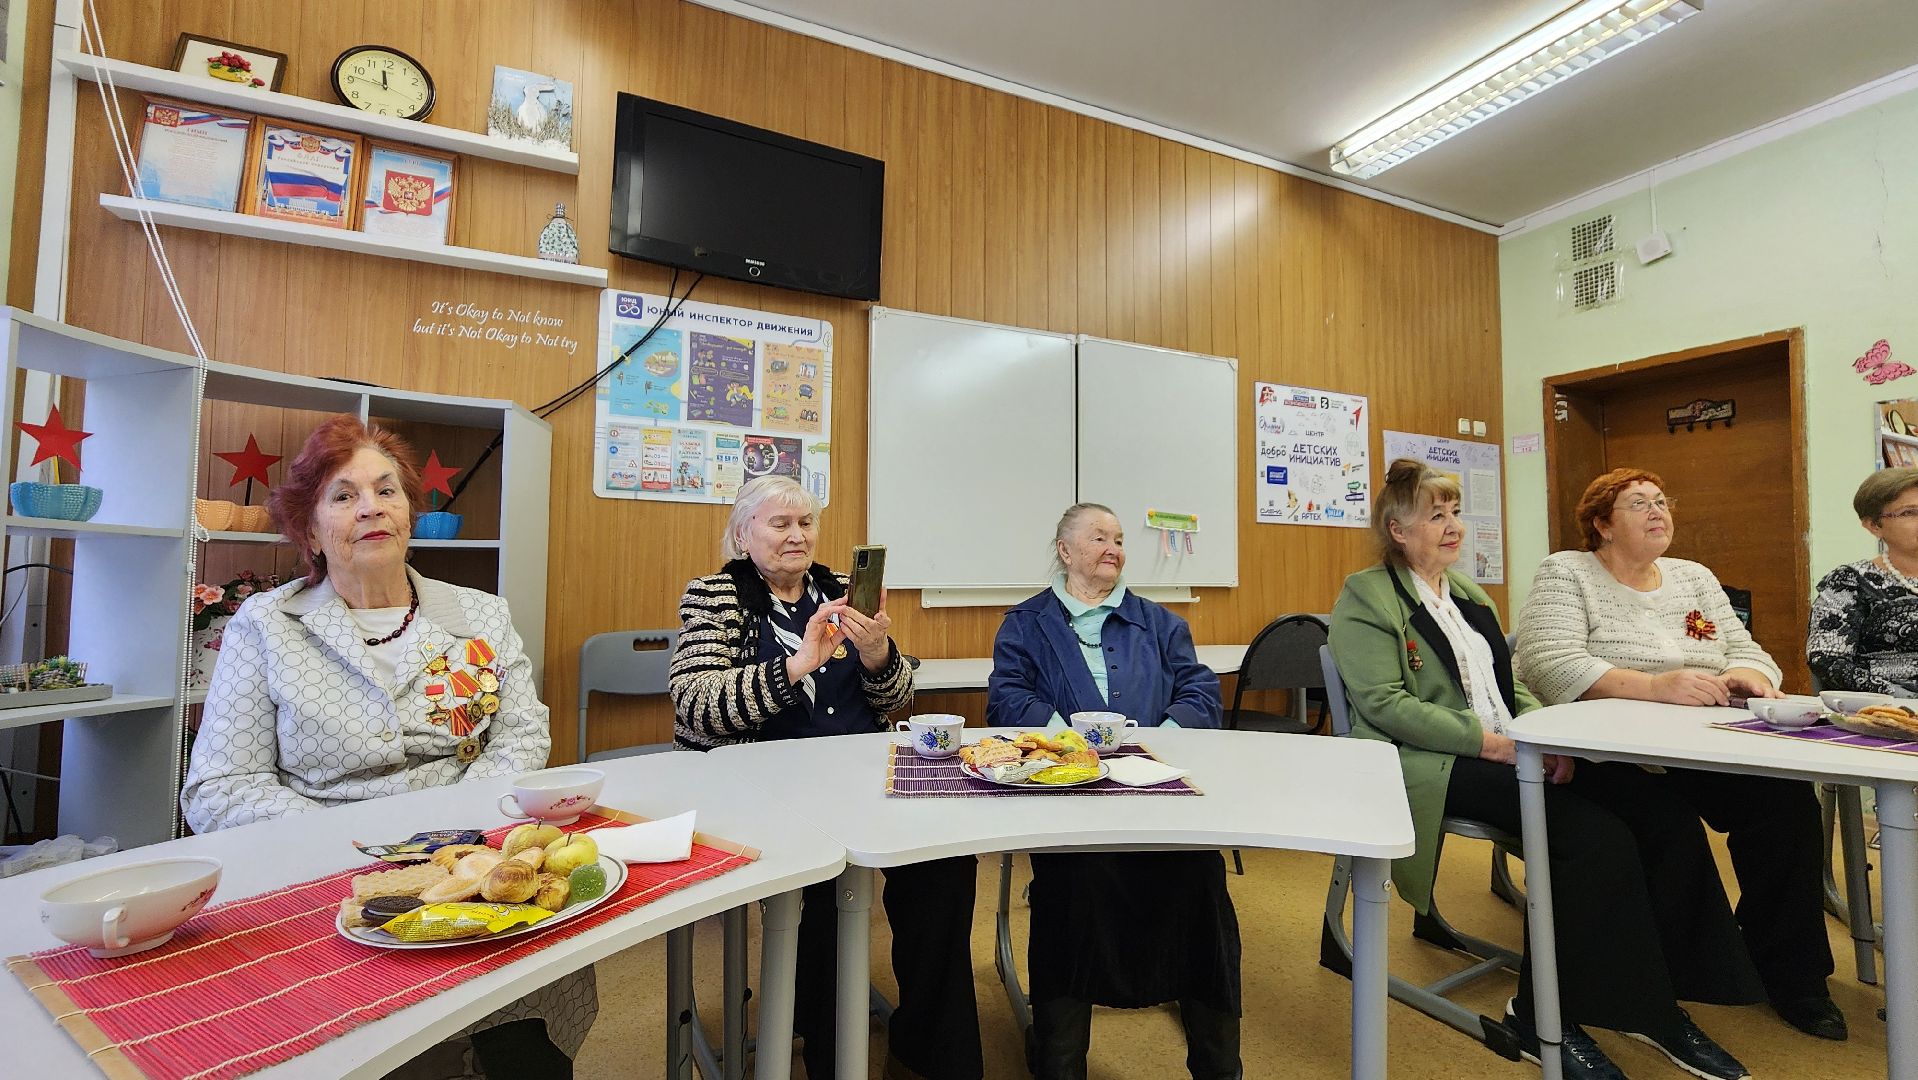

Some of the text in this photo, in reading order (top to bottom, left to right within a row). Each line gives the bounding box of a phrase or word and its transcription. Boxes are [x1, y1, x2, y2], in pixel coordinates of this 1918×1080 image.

[367, 59, 376, 69] 11
[384, 59, 394, 70] 12
[354, 65, 366, 76] 10
[347, 75, 355, 84] 9
[411, 77, 419, 87] 2
[351, 90, 359, 99] 8
[416, 92, 423, 101] 3
[364, 101, 372, 110] 7
[408, 104, 416, 112] 4
[431, 301, 564, 327] It's Okay to Not know
[689, 312, 753, 328] ИНСПЕКТОР
[756, 321, 813, 337] ДВИЖЕНИЯ
[413, 318, 578, 355] but it's Not Okay to Not try
[1292, 443, 1338, 456] ДЕТСКИХ
[1428, 446, 1458, 457] ДЕТСКИХ
[1289, 453, 1341, 467] ИНИЦИАТИВ
[1426, 454, 1461, 464] ИНИЦИАТИВ
